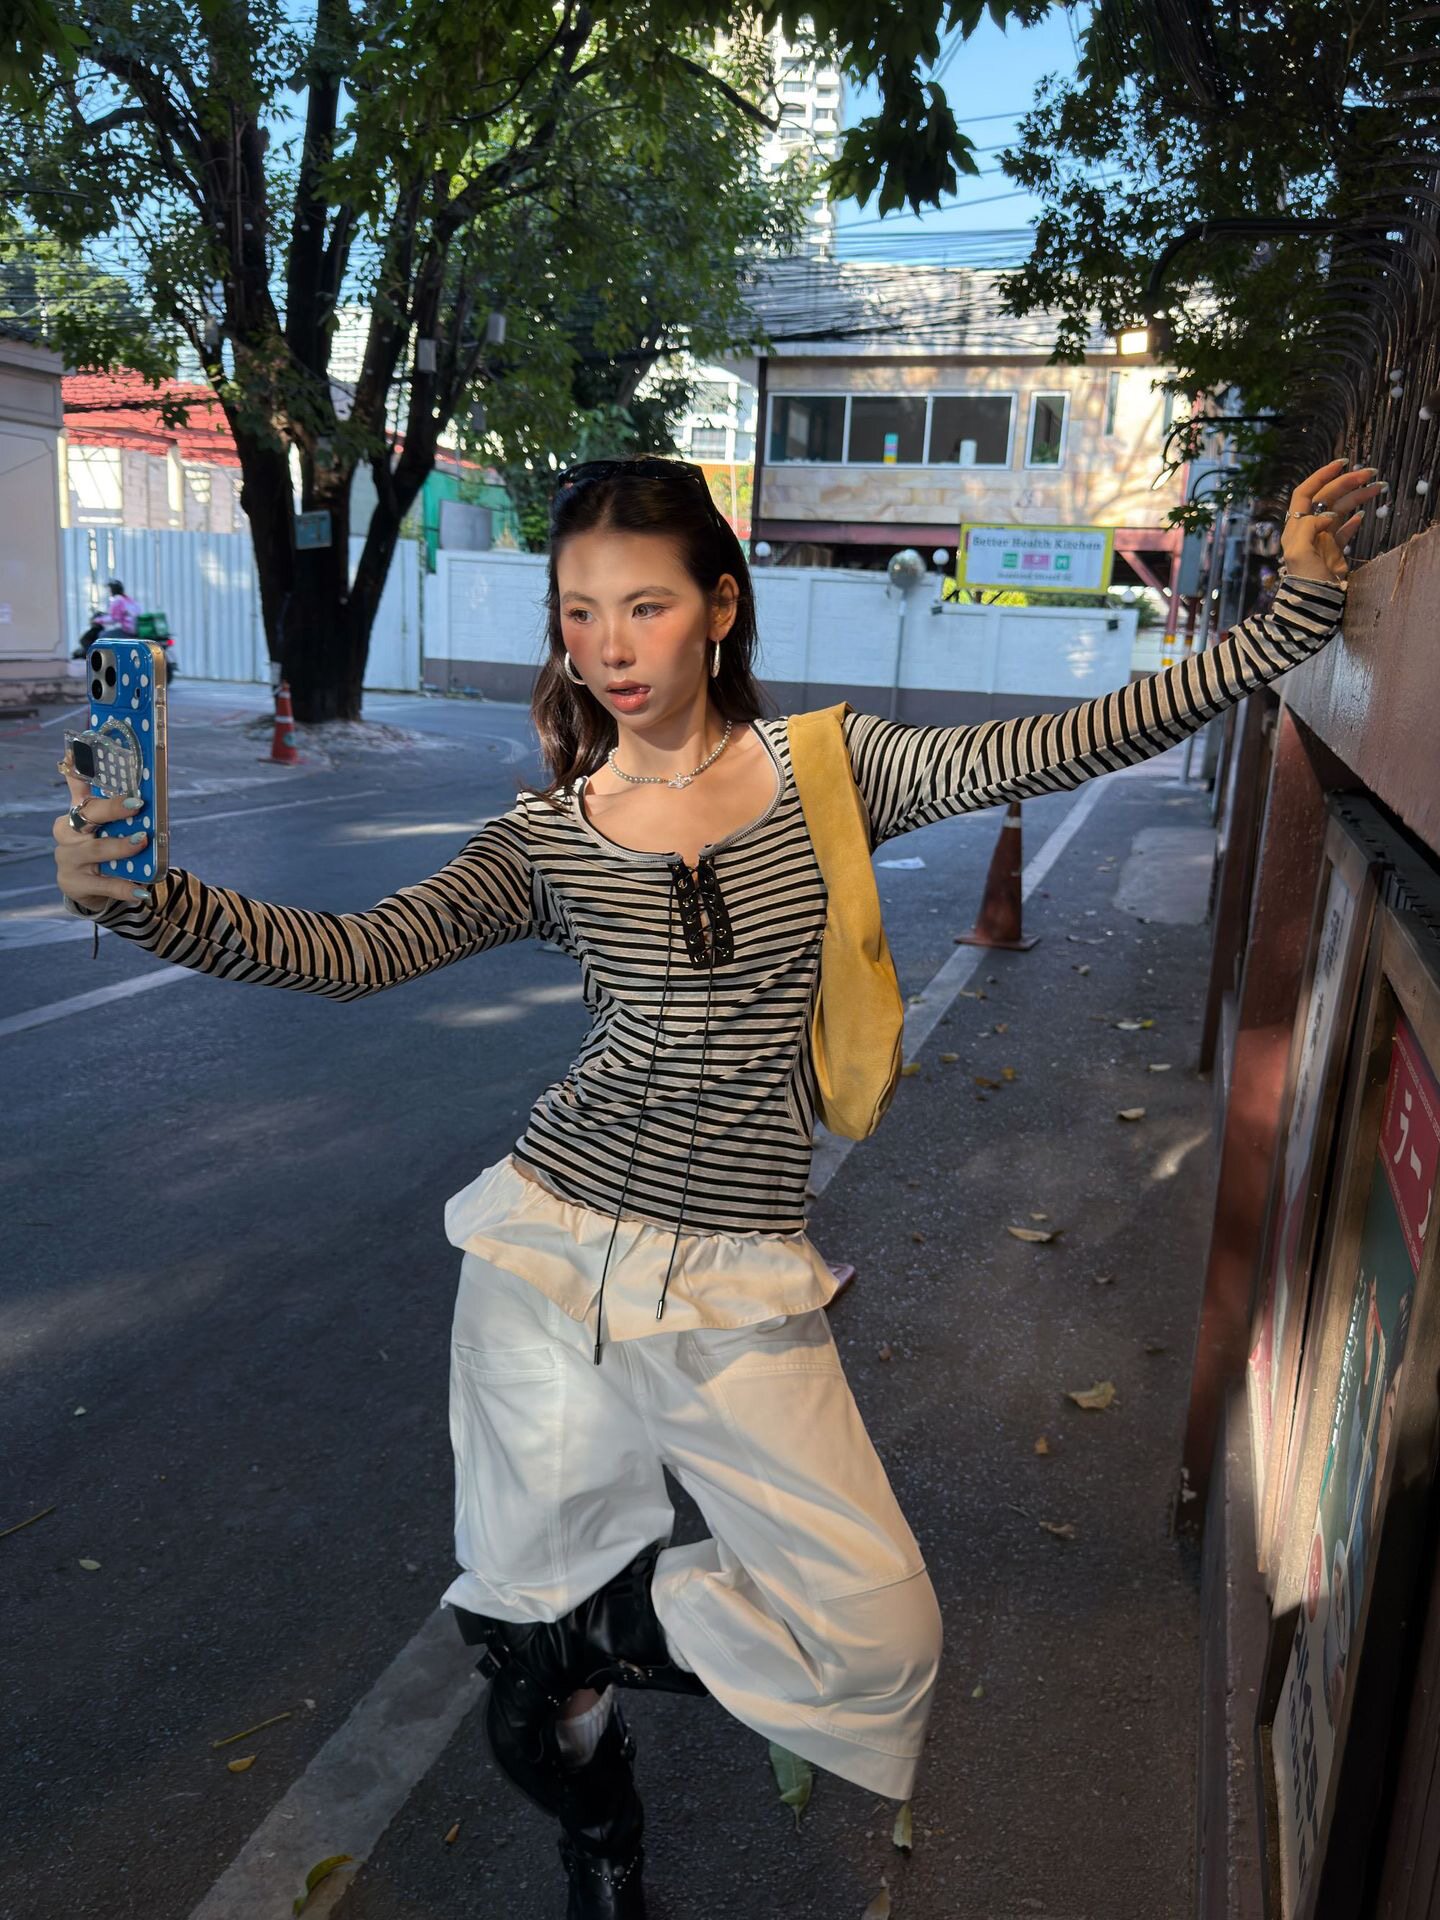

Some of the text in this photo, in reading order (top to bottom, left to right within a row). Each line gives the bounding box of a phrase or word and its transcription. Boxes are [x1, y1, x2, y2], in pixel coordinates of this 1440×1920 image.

[973, 536, 1102, 550] Better Health Kitchen
